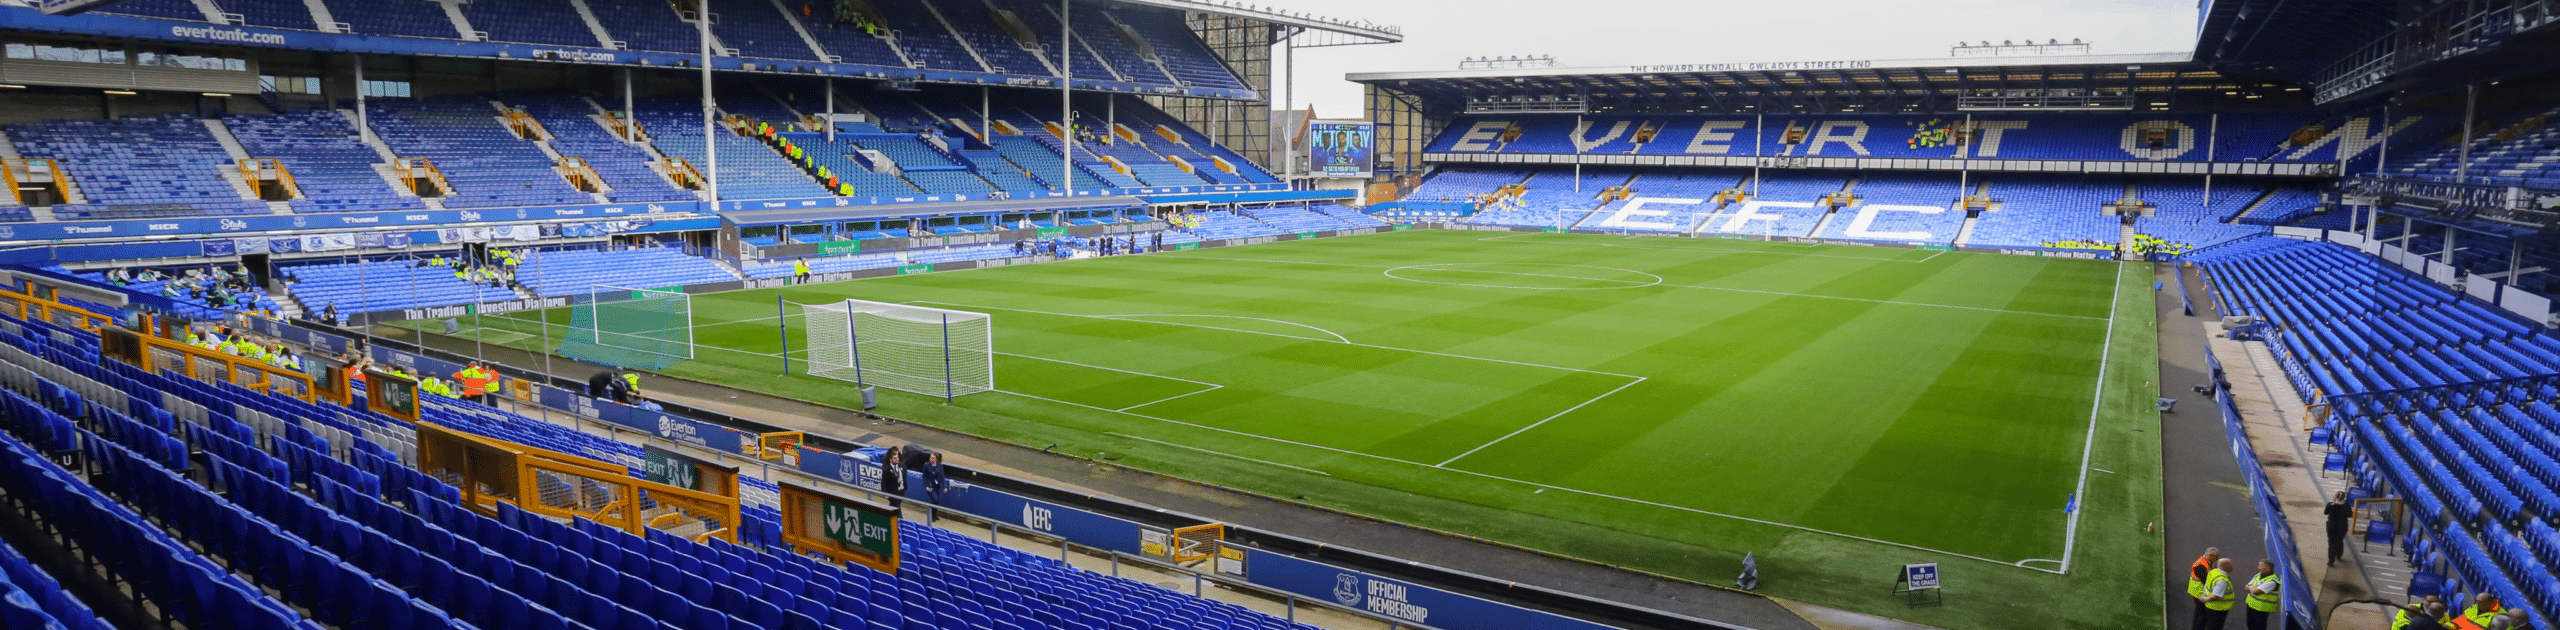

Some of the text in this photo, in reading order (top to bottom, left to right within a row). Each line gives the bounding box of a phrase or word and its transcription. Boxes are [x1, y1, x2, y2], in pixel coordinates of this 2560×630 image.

[172, 25, 285, 45] evertonfc.com
[1631, 59, 1871, 73] THE HOWARD KENDALL GWLADYS STREET END
[149, 223, 179, 231] KICK
[404, 308, 424, 320] The
[670, 419, 696, 436] Everton
[684, 434, 707, 447] Community
[63, 455, 72, 466] U
[647, 460, 665, 476] EXIT
[1033, 506, 1052, 532] EFC
[863, 522, 888, 542] EXIT
[1368, 579, 1408, 603] OFFICIAL
[1367, 595, 1428, 623] MEMBERSHIP
